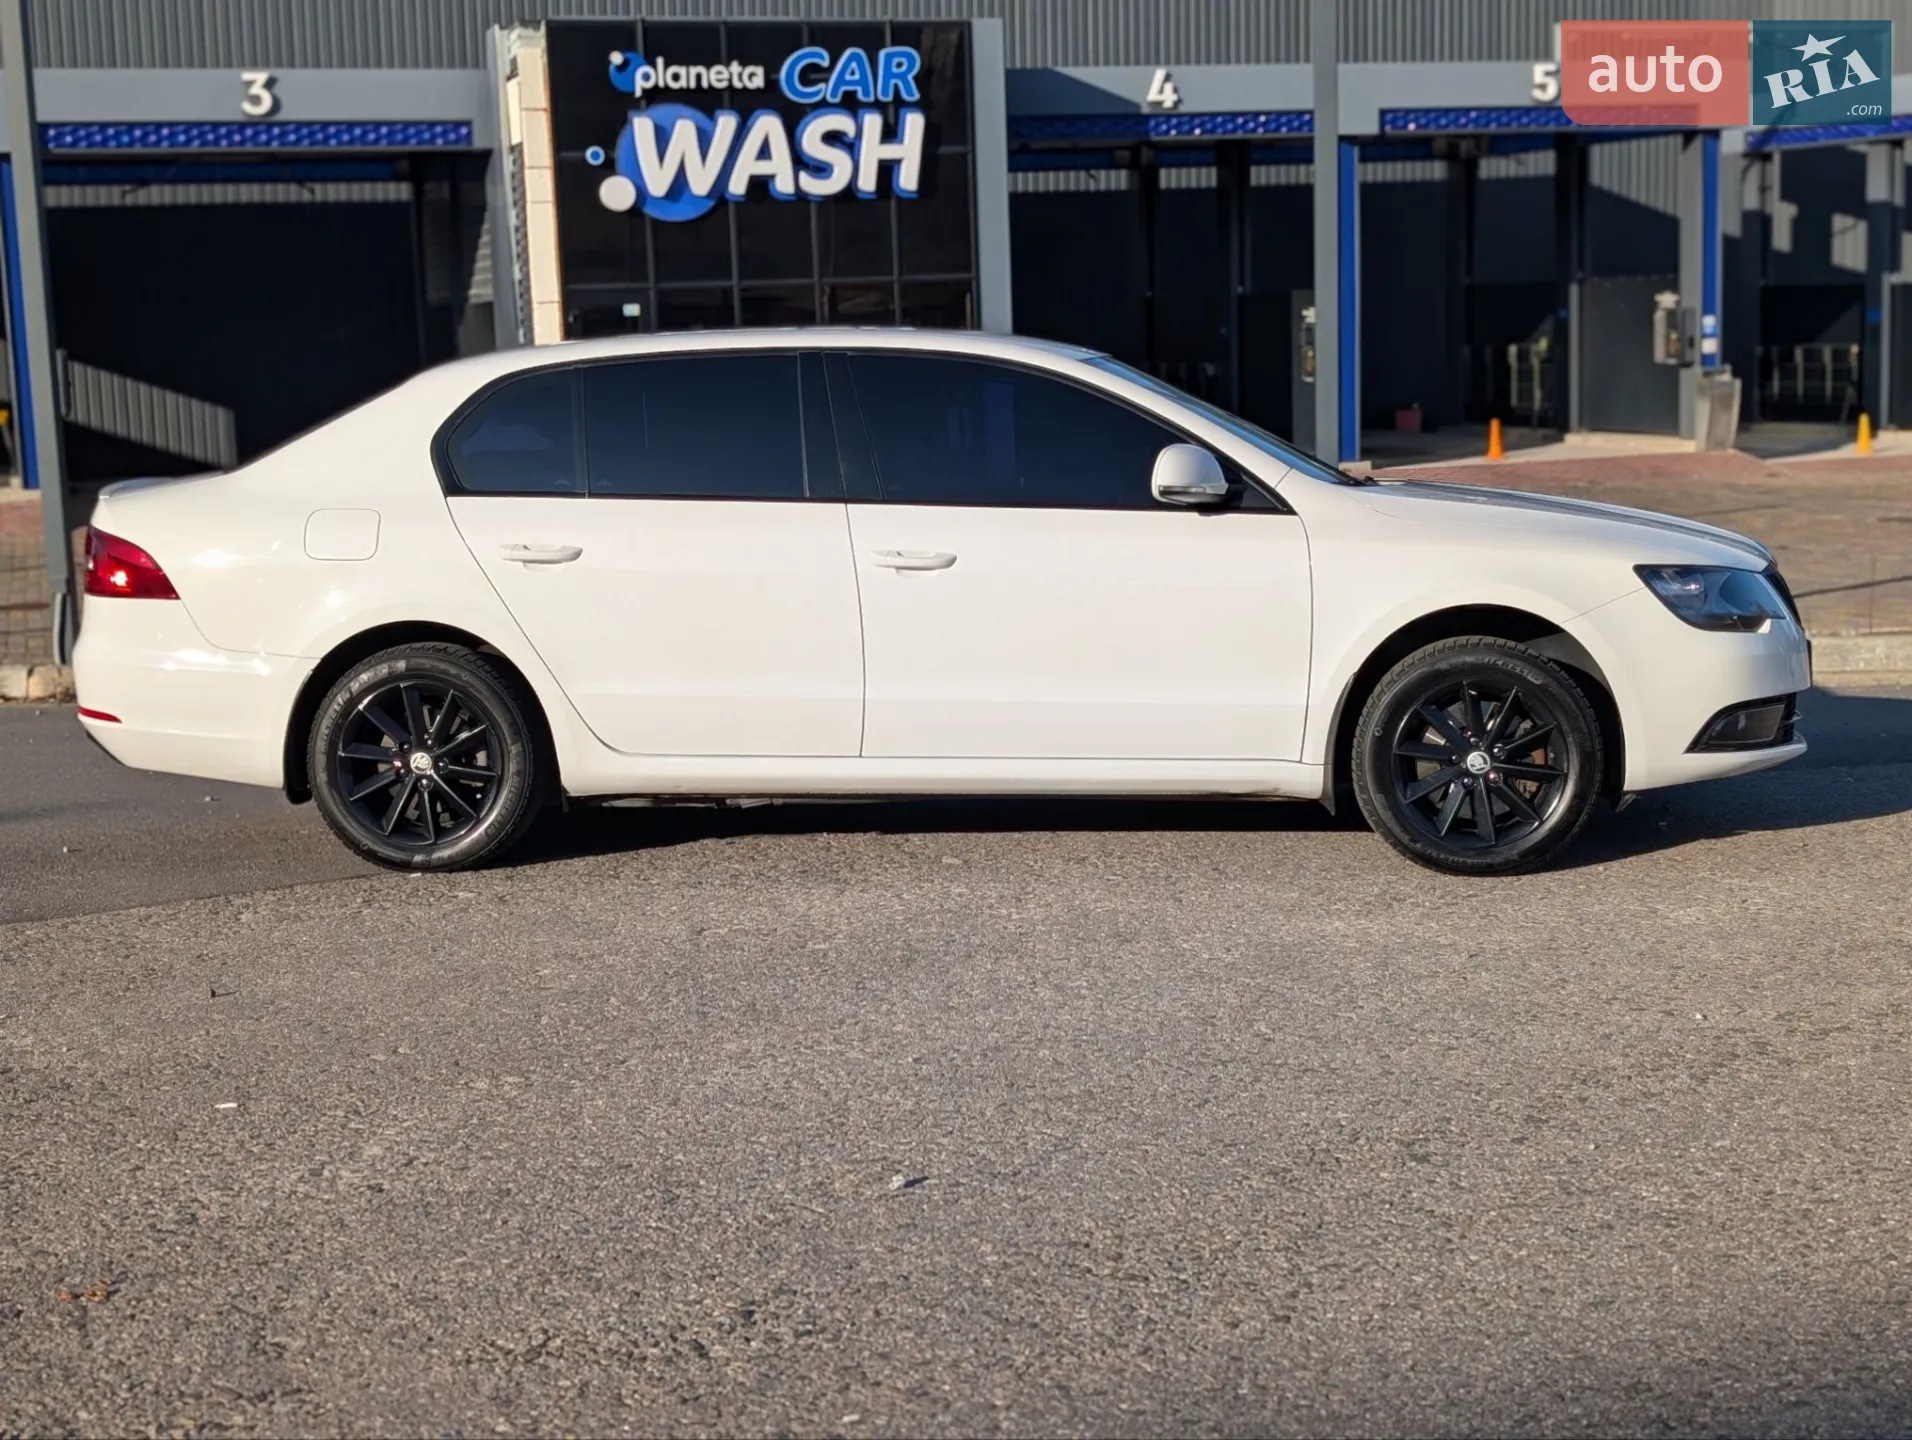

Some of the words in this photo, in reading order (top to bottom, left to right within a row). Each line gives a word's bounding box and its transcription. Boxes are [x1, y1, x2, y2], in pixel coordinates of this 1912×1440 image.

[241, 72, 272, 115] 3
[634, 56, 764, 98] planeta
[780, 46, 920, 103] CAR
[1147, 69, 1178, 108] 4
[1531, 63, 1560, 101] 5
[629, 110, 926, 198] WASH
